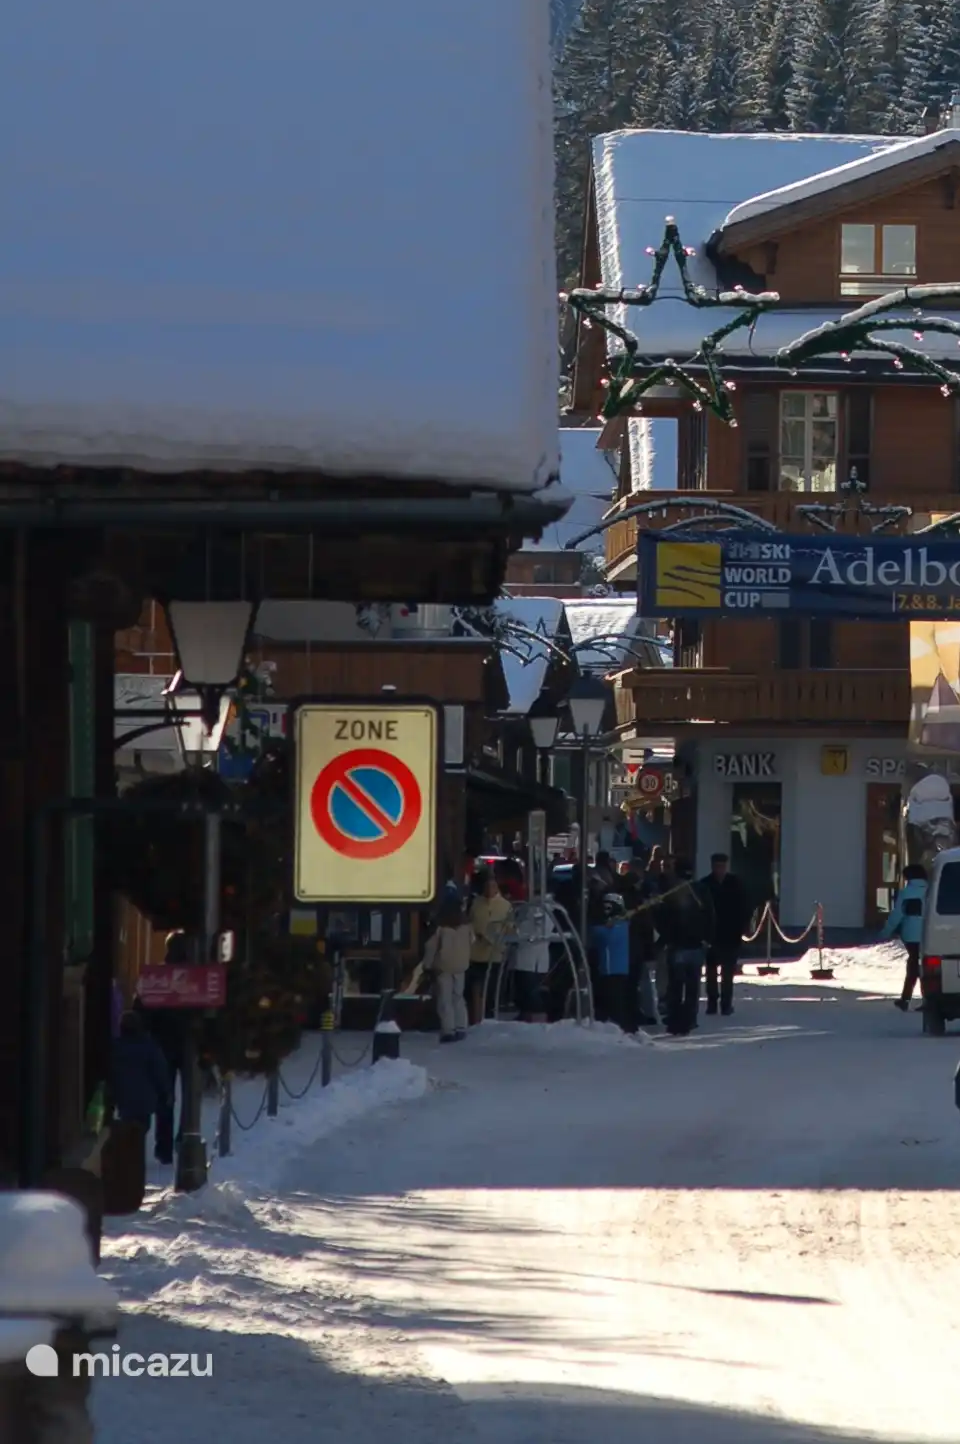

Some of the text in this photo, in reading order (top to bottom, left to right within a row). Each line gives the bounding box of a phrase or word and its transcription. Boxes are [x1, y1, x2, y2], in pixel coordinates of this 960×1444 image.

[761, 543, 791, 560] SKI
[724, 567, 792, 584] WORLD
[724, 592, 761, 608] CUP
[334, 720, 399, 740] ZONE
[714, 754, 774, 776] BANK
